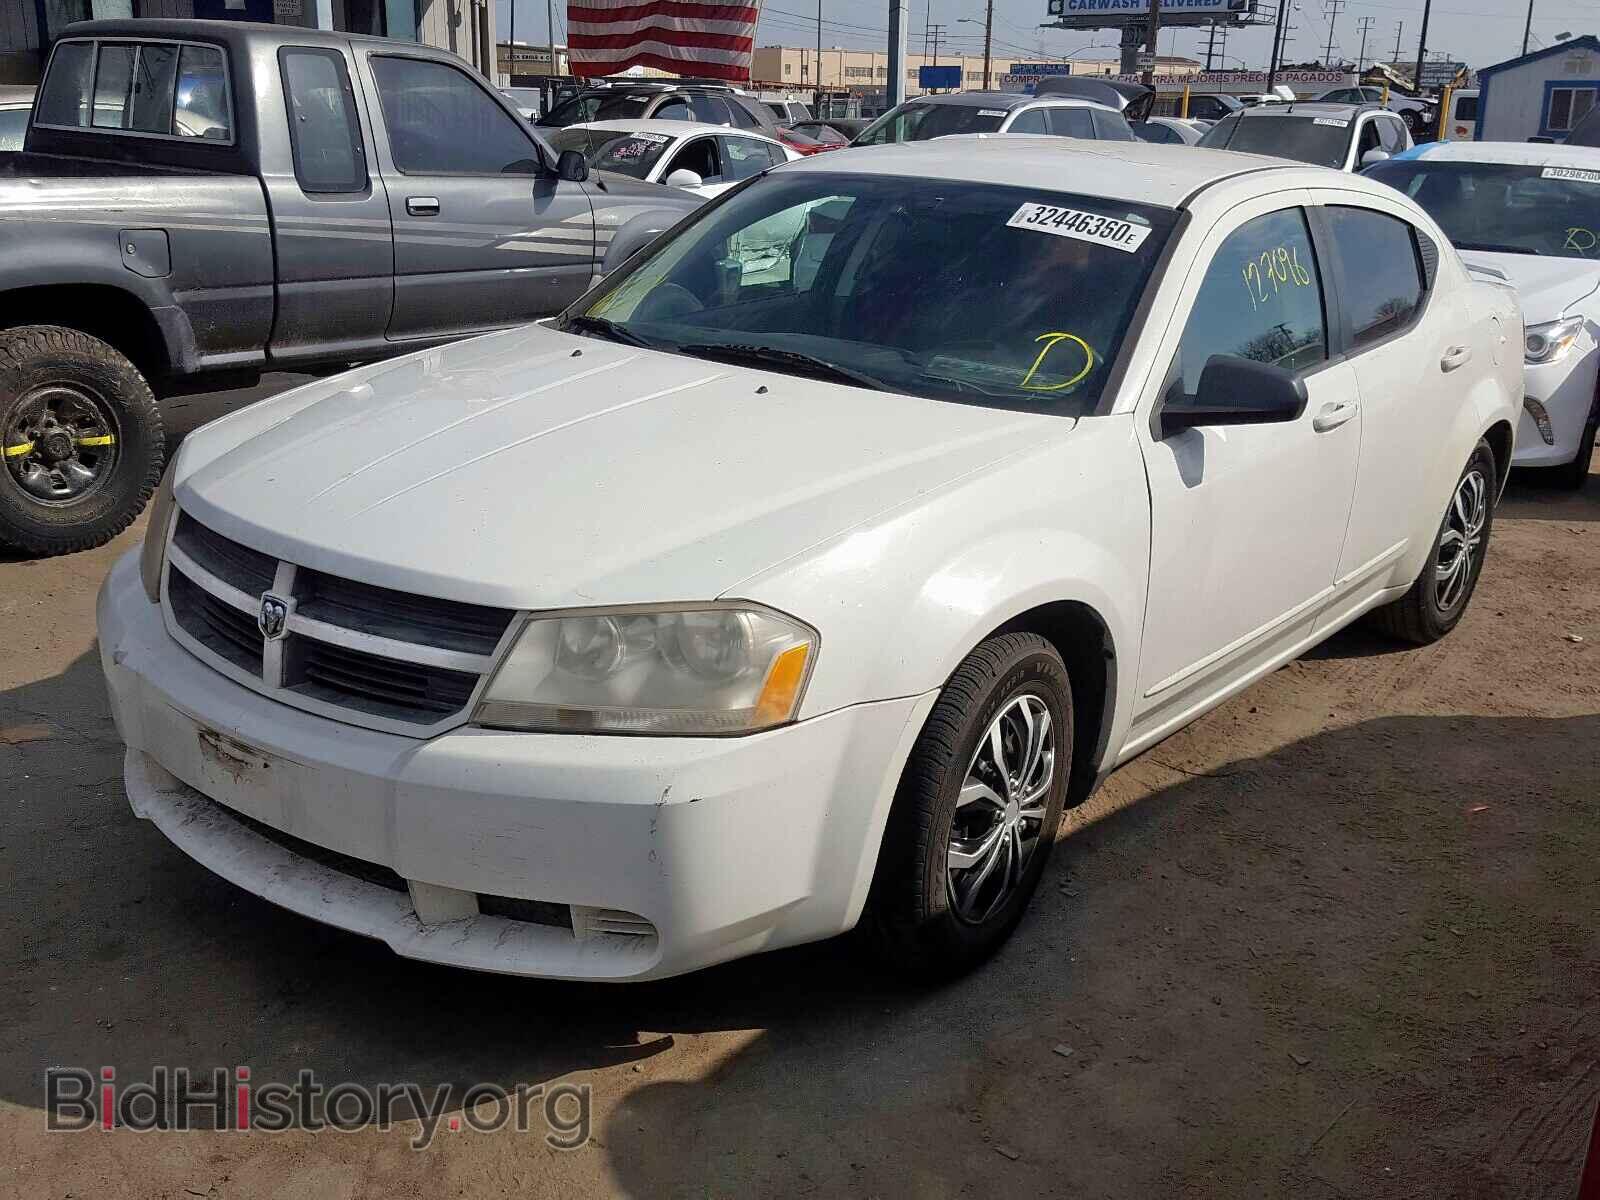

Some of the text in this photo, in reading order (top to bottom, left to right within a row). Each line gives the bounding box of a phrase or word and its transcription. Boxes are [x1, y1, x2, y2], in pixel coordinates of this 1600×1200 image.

[1068, 0, 1144, 10] CARWASH
[1178, 74, 1229, 83] MEJORES
[1286, 72, 1343, 82] PAGADOS
[1027, 206, 1131, 242] 32446360
[1020, 332, 1094, 391] D
